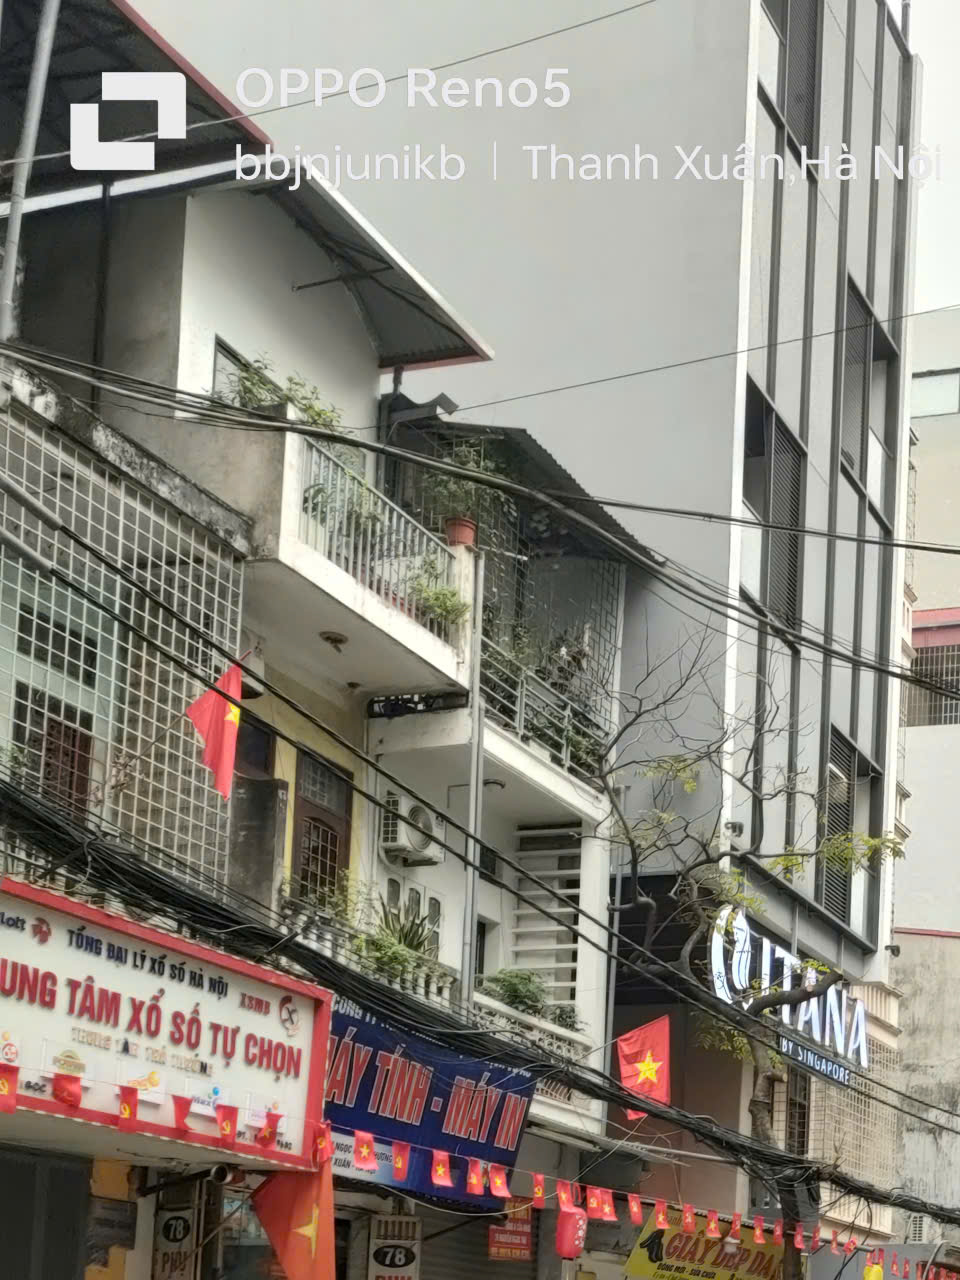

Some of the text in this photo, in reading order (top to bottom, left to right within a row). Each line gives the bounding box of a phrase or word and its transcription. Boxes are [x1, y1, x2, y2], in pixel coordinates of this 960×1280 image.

[133, 949, 147, 970] LÝ
[169, 961, 186, 983] SỐ
[189, 968, 204, 988] HÀ
[208, 976, 229, 1002] NỘI
[239, 993, 271, 1016] XSMB
[66, 975, 122, 1027] TÂM
[126, 988, 165, 1038] XỔ
[170, 1002, 203, 1049] SỐ
[208, 1022, 241, 1067] TỰ
[244, 1033, 302, 1082] CHỌN
[797, 1045, 850, 1085] SINGAPORE
[367, 1044, 434, 1126] TÍNH
[442, 1072, 503, 1143] MÁY
[494, 1094, 528, 1151] IN
[335, 1142, 352, 1154] NGỌC
[168, 1219, 185, 1240] 78
[383, 1248, 406, 1265] 78
